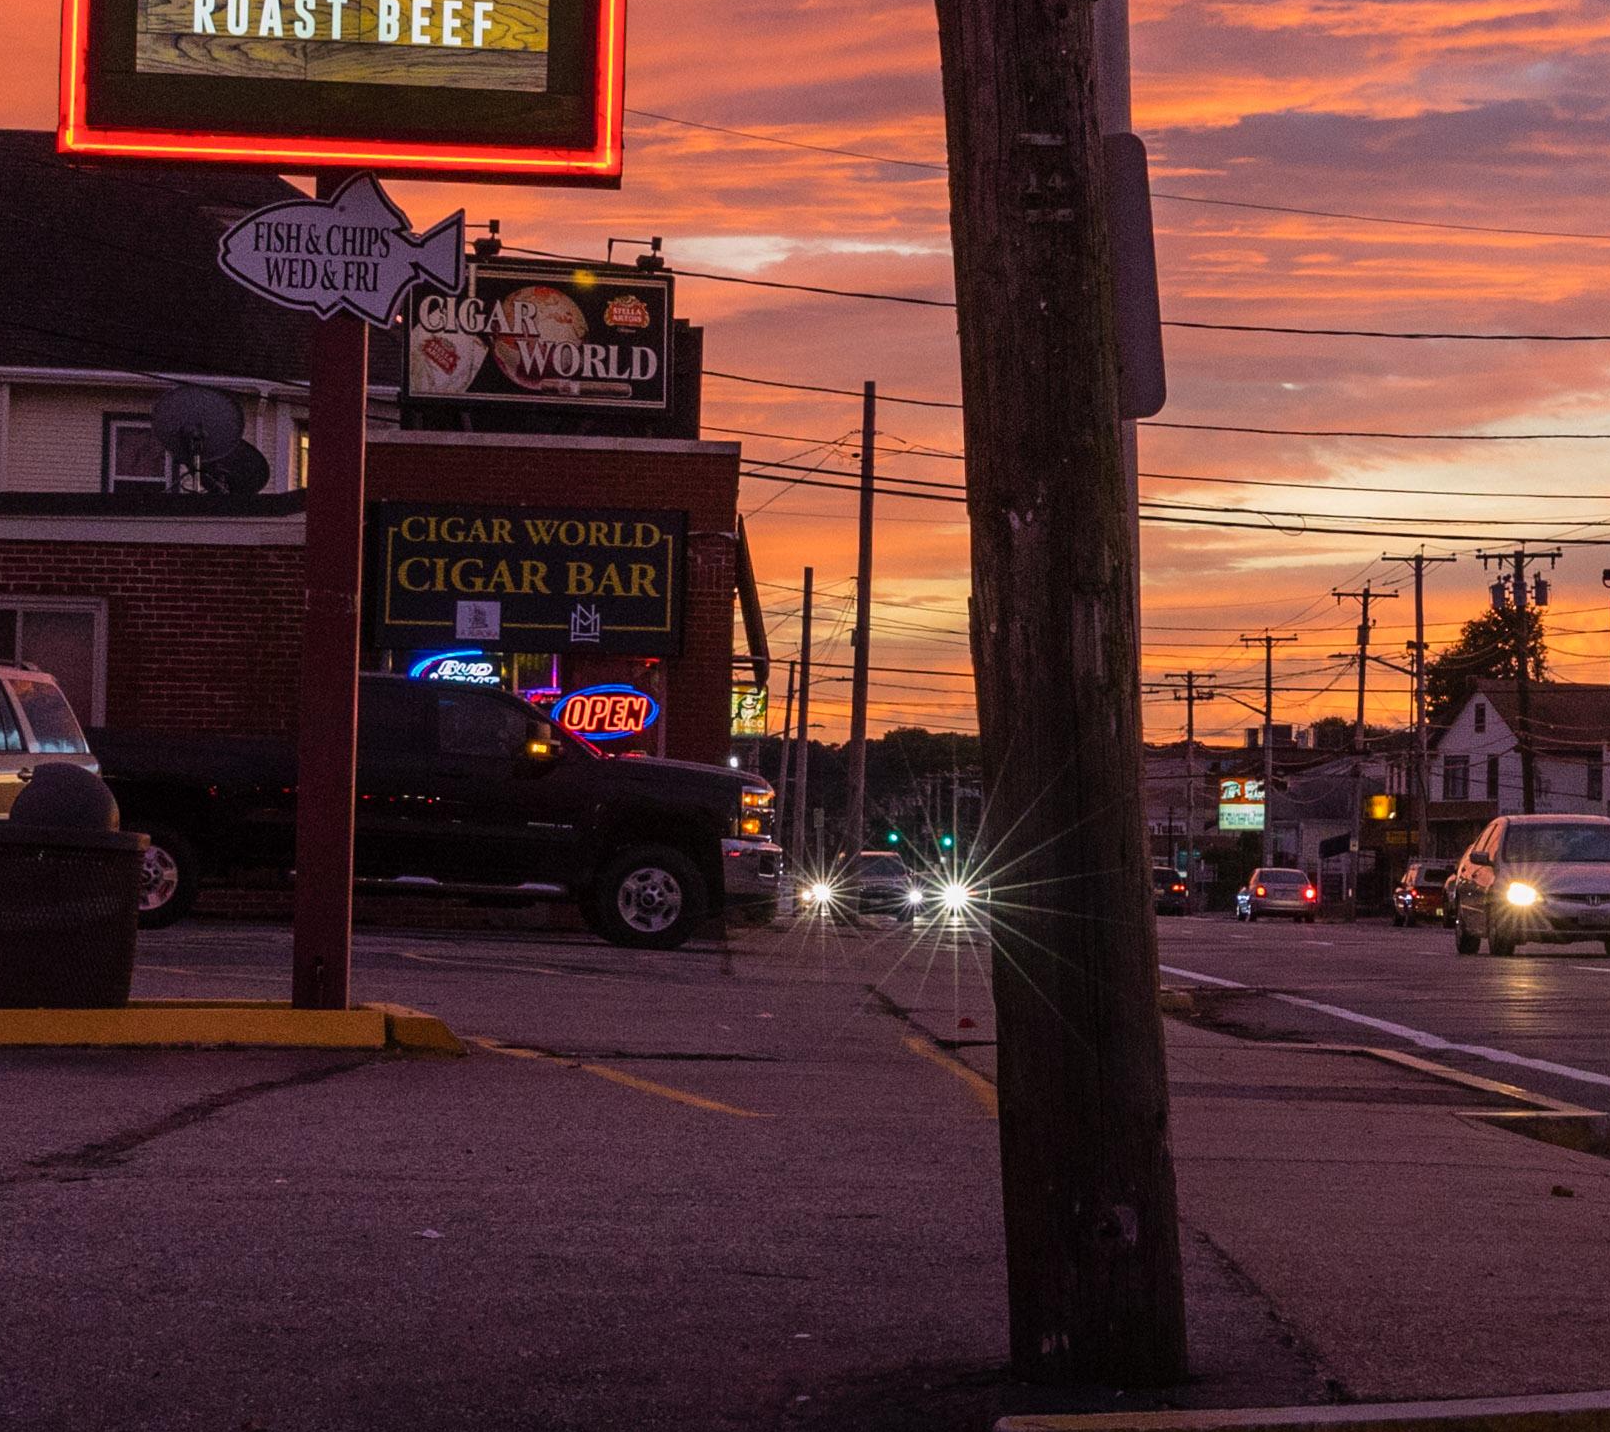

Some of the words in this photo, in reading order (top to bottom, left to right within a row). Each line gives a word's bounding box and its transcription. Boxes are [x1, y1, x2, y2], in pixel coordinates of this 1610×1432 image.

[253, 222, 302, 254] FISH
[305, 224, 323, 255] &
[326, 224, 390, 258] CHIPS
[265, 258, 317, 289] WED
[321, 260, 339, 291] &
[342, 262, 380, 292] FRI
[419, 295, 539, 335] CIGAR
[516, 340, 658, 381] WORLD
[401, 516, 515, 544] CIGAR
[524, 519, 661, 548] WORLD
[397, 557, 552, 594] CIGAR
[565, 562, 660, 597] BAR
[564, 696, 648, 731] OPEN
